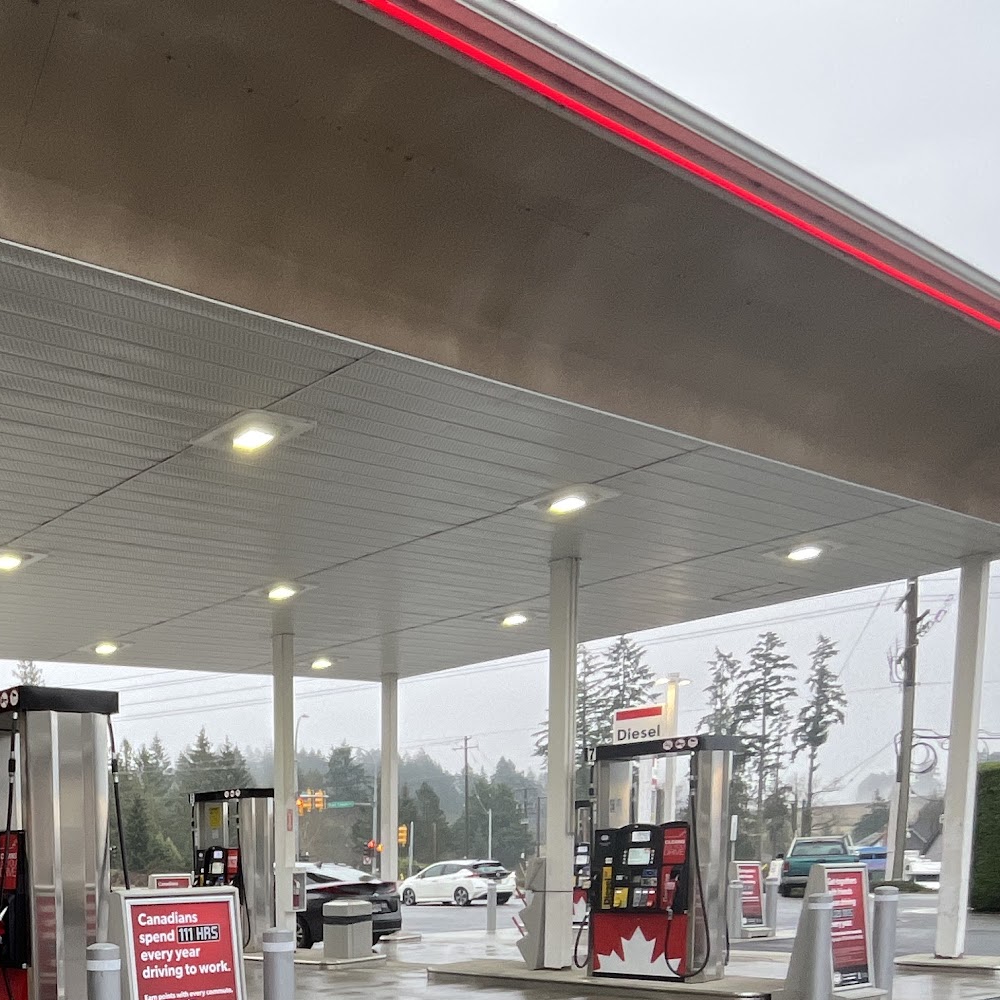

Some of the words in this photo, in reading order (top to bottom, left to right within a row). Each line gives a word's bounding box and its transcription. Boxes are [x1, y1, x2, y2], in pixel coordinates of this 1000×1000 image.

[617, 724, 660, 741] Diesel
[589, 748, 595, 760] 7
[137, 911, 198, 926] Canadians
[139, 929, 175, 946] spend
[178, 927, 194, 942] 111
[196, 925, 219, 941] HRS
[140, 949, 173, 962] every
[175, 947, 201, 961] year
[142, 964, 183, 979] driving
[185, 963, 197, 975] to
[199, 960, 231, 974] work.
[176, 990, 189, 999] with
[189, 989, 206, 998] every
